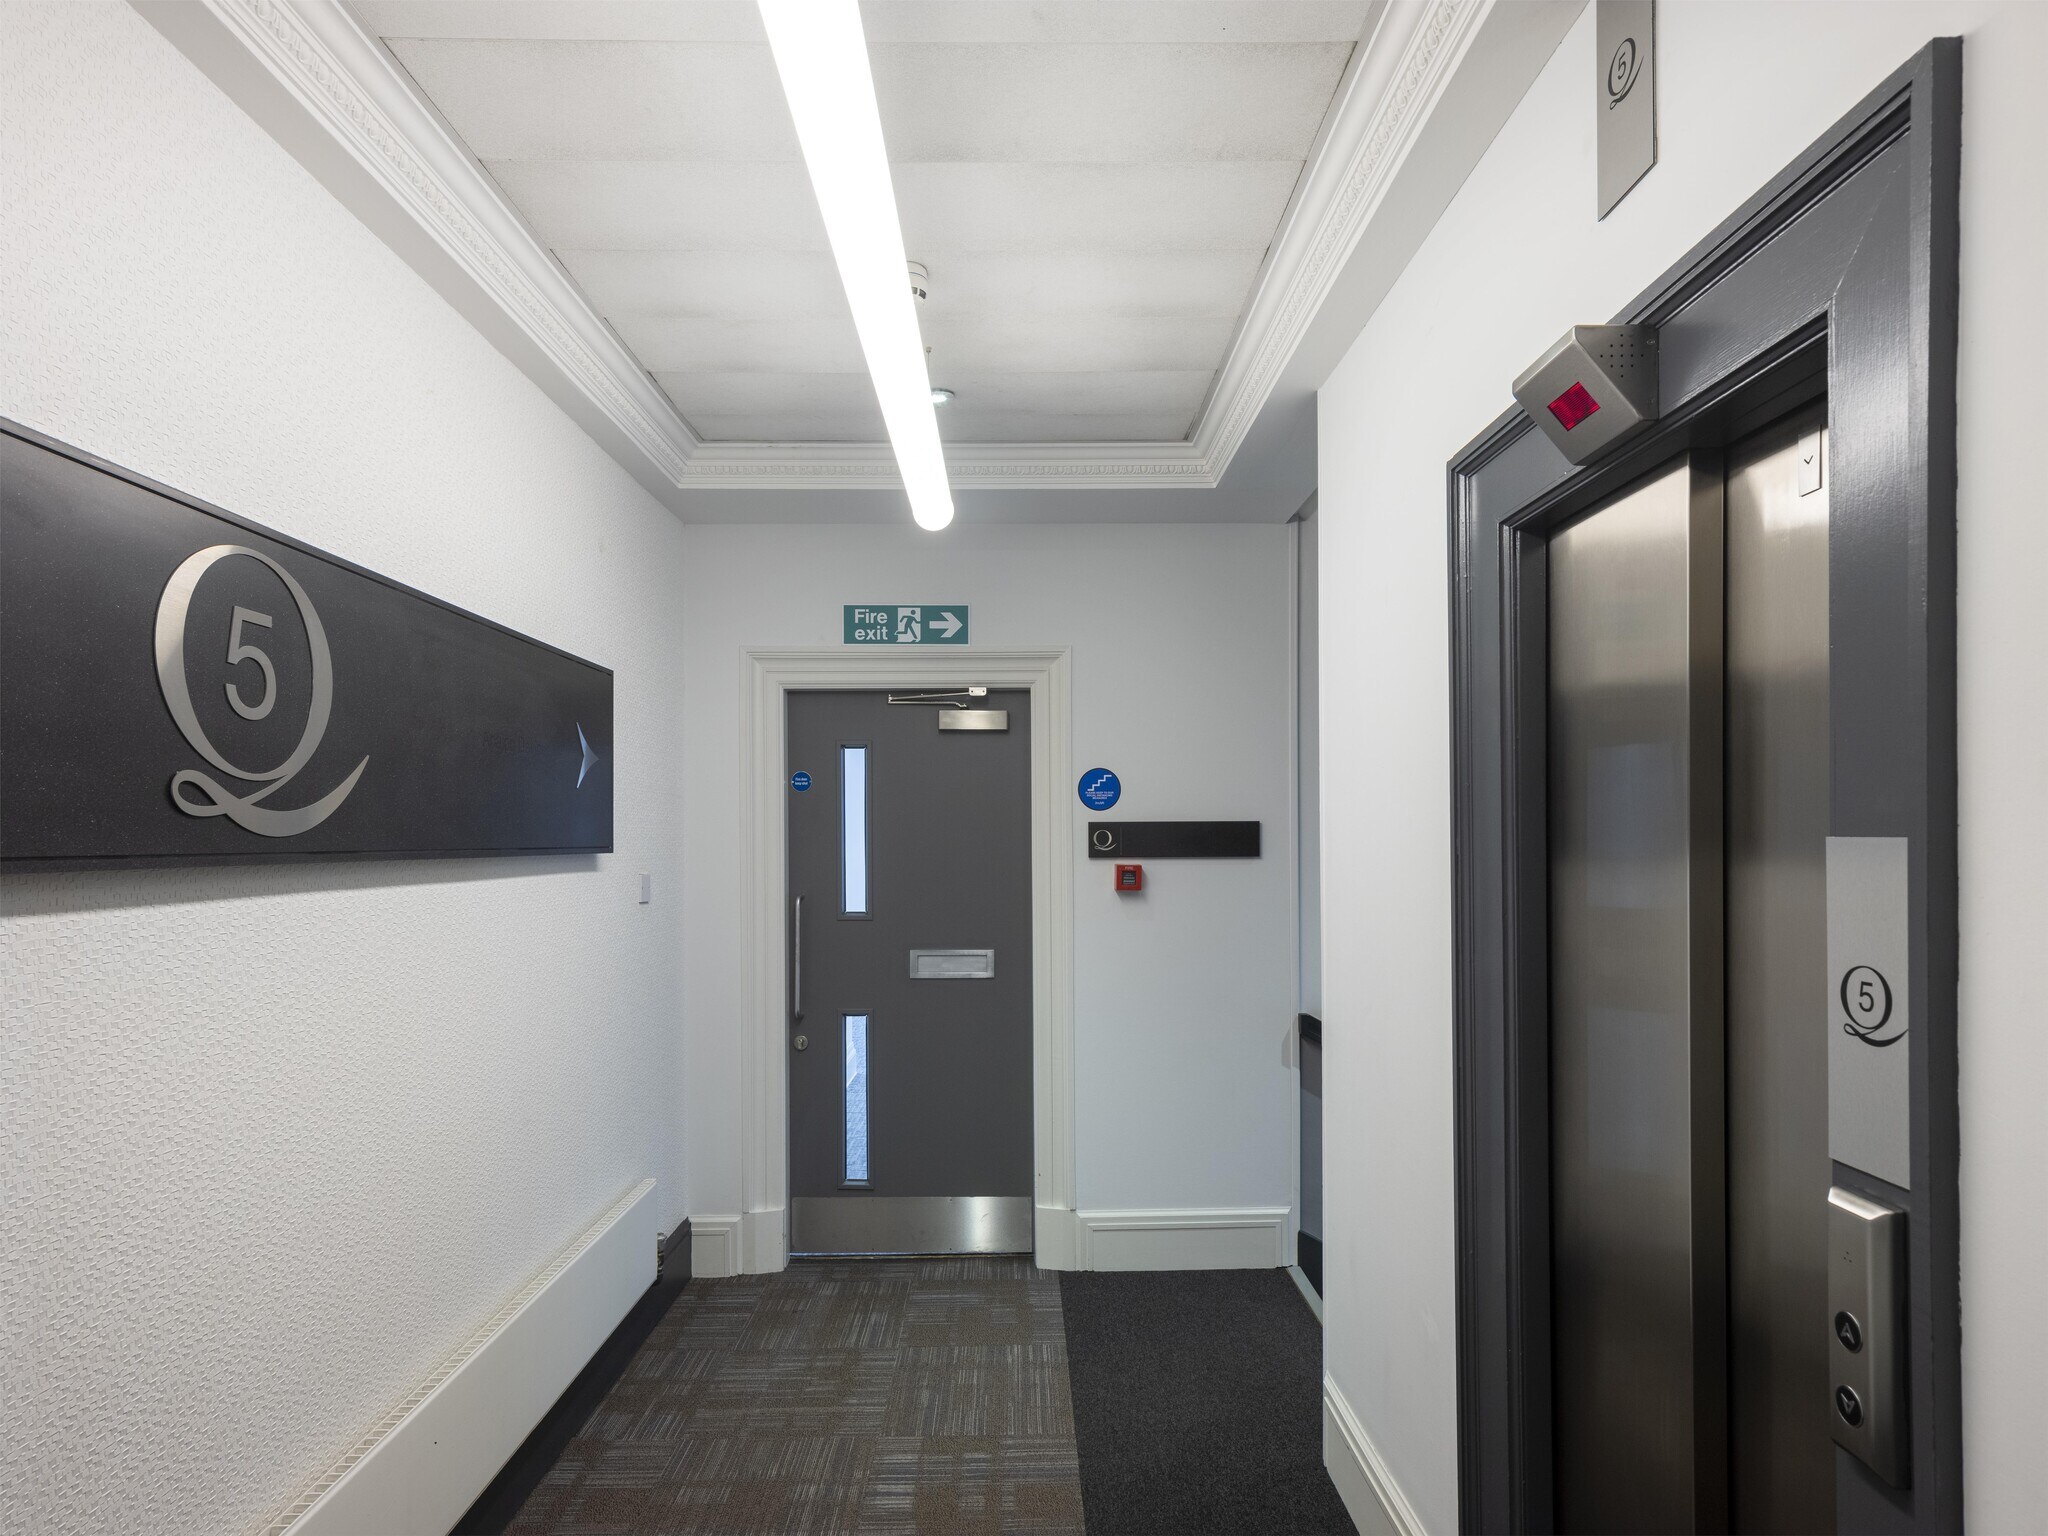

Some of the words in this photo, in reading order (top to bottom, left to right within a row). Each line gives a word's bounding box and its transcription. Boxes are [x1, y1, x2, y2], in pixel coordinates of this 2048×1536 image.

[854, 608, 888, 624] Fire
[854, 626, 888, 641] exit
[225, 605, 277, 721] 5
[1093, 829, 1118, 851] Q
[1859, 980, 1875, 1013] 5
